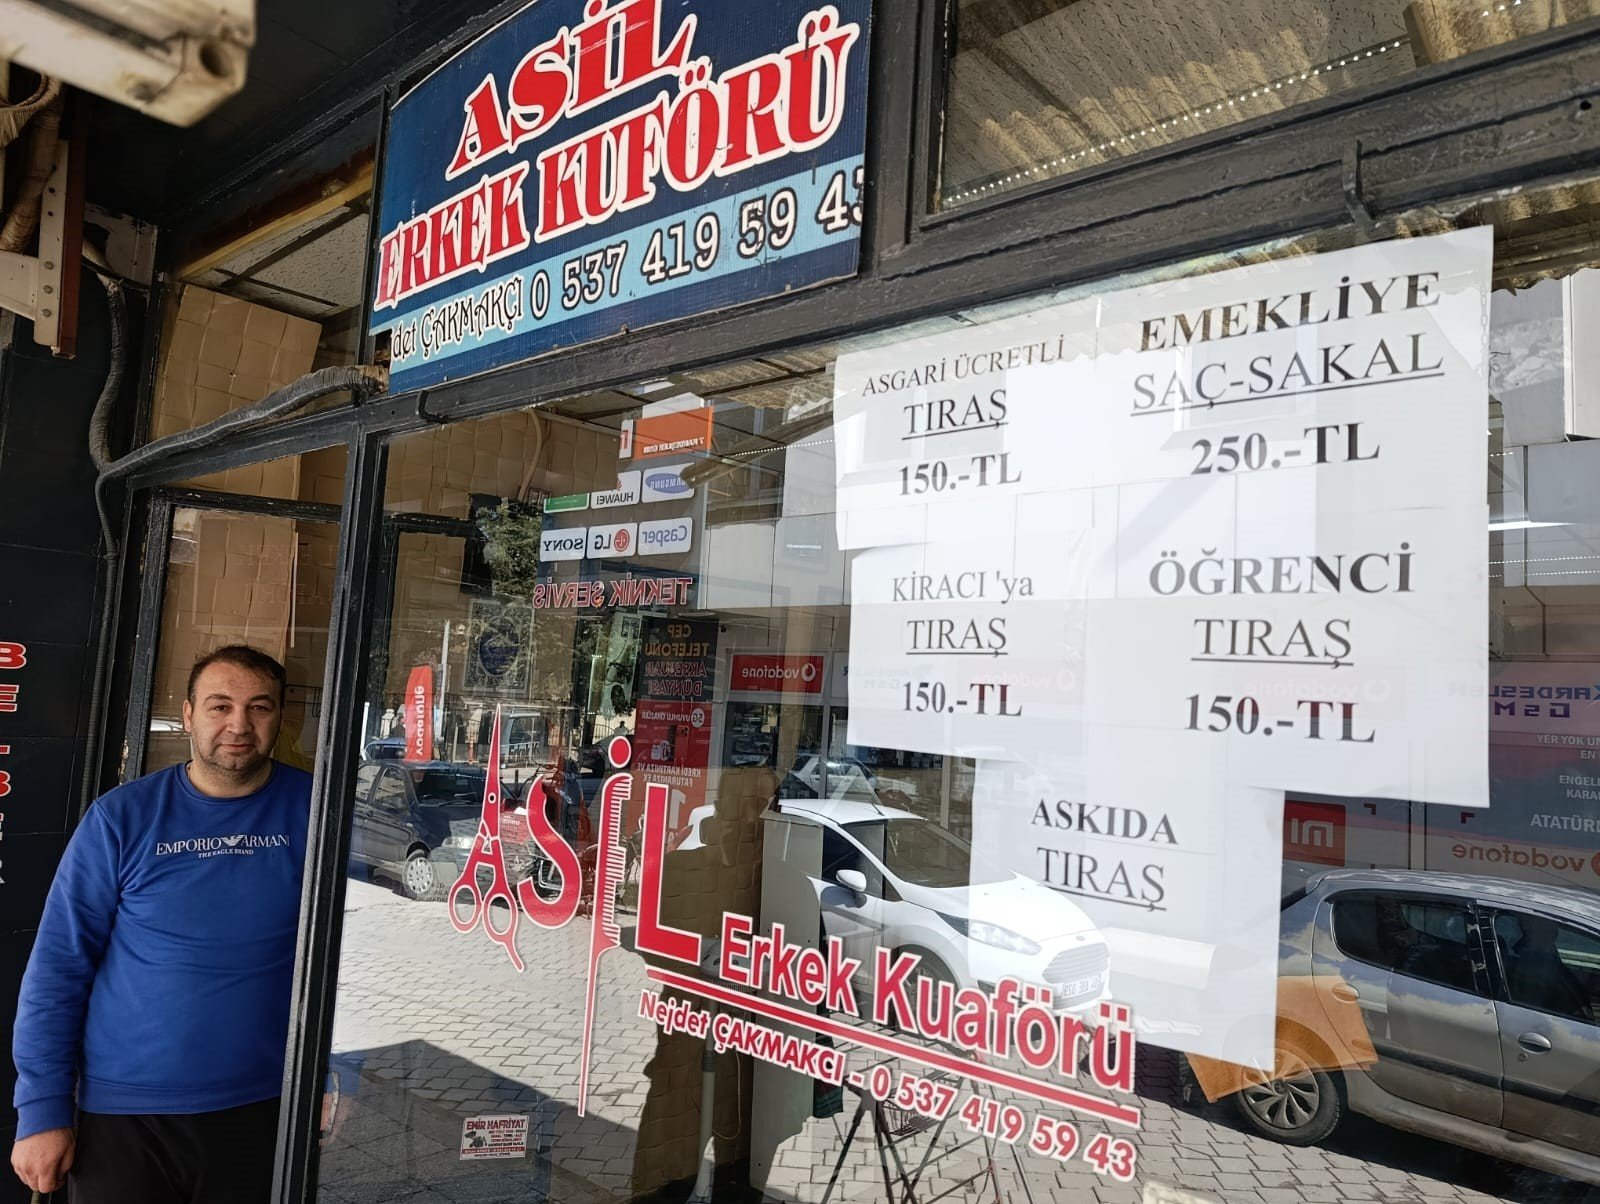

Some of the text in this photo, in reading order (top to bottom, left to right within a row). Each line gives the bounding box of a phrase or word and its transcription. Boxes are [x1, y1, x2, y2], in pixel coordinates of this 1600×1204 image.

[446, 0, 697, 180] ASİL
[375, 5, 859, 312] ERKEK KUFÖRÜ
[390, 320, 417, 360] det
[420, 274, 524, 357] ÇAKMAKÇI
[531, 270, 550, 320] 0
[562, 241, 629, 309] 537
[641, 213, 720, 284] 419
[738, 186, 798, 259] 59
[1139, 271, 1440, 354] EMEKLİYE
[862, 334, 1065, 397] ASGARİ ÜCRETLİ
[1132, 332, 1444, 414] SAÇ-SAKAL
[902, 389, 1009, 433] TIRAŞ
[898, 452, 1023, 496] 150.-TL
[1190, 422, 1381, 476] 250.-TL
[892, 569, 987, 602] KİRACI
[1149, 541, 1415, 597] ÖĞRENCİ
[906, 618, 1008, 657] TIRAŞ
[1192, 618, 1354, 668] TIRAŞ
[901, 681, 1023, 718] 150.-TL
[1184, 693, 1376, 744] 150.-TL
[1537, 734, 1559, 745] YER
[1560, 735, 1585, 746] YOK
[1580, 750, 1596, 760] EN
[1566, 788, 1600, 801] KARA
[155, 836, 222, 857] EMPORIO
[1030, 797, 1179, 846] ASKIDA
[1036, 846, 1167, 912] TIRAŞ
[719, 911, 1136, 1093] Erkek Kuaförü
[638, 990, 711, 1037] Nejdet
[870, 1066, 891, 1100] 0
[897, 1076, 957, 1120] 537
[959, 1097, 1025, 1143] 419
[1029, 1117, 1081, 1161] 59
[1084, 1135, 1138, 1183] 43
